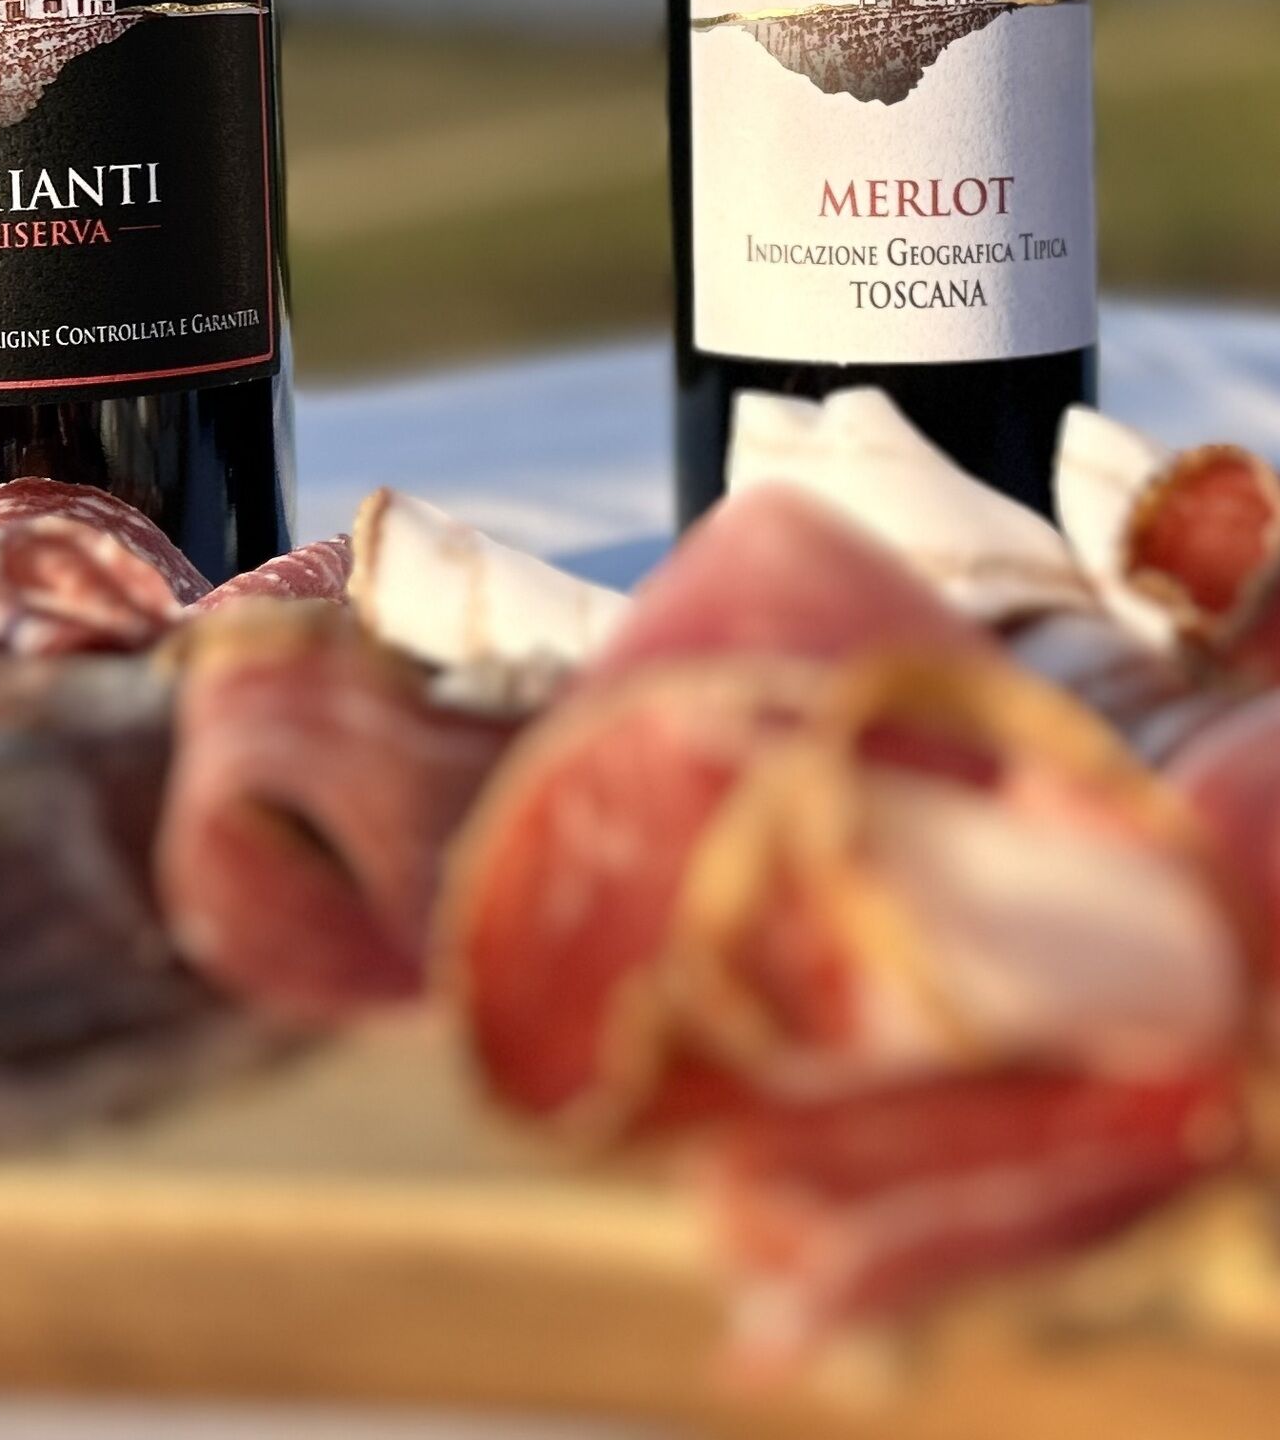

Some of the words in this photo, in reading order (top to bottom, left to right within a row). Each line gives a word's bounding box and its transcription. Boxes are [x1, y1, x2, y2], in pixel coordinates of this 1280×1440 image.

[818, 176, 1015, 218] MERLOT
[746, 234, 878, 266] INDICAZIONE
[887, 237, 1014, 268] GEOGRAFICA
[1019, 232, 1068, 260] TIPICA
[849, 279, 988, 309] TOSCANA
[55, 319, 176, 347] CONTROLLATA
[180, 318, 188, 336] E
[191, 308, 260, 334] GARANTITA
